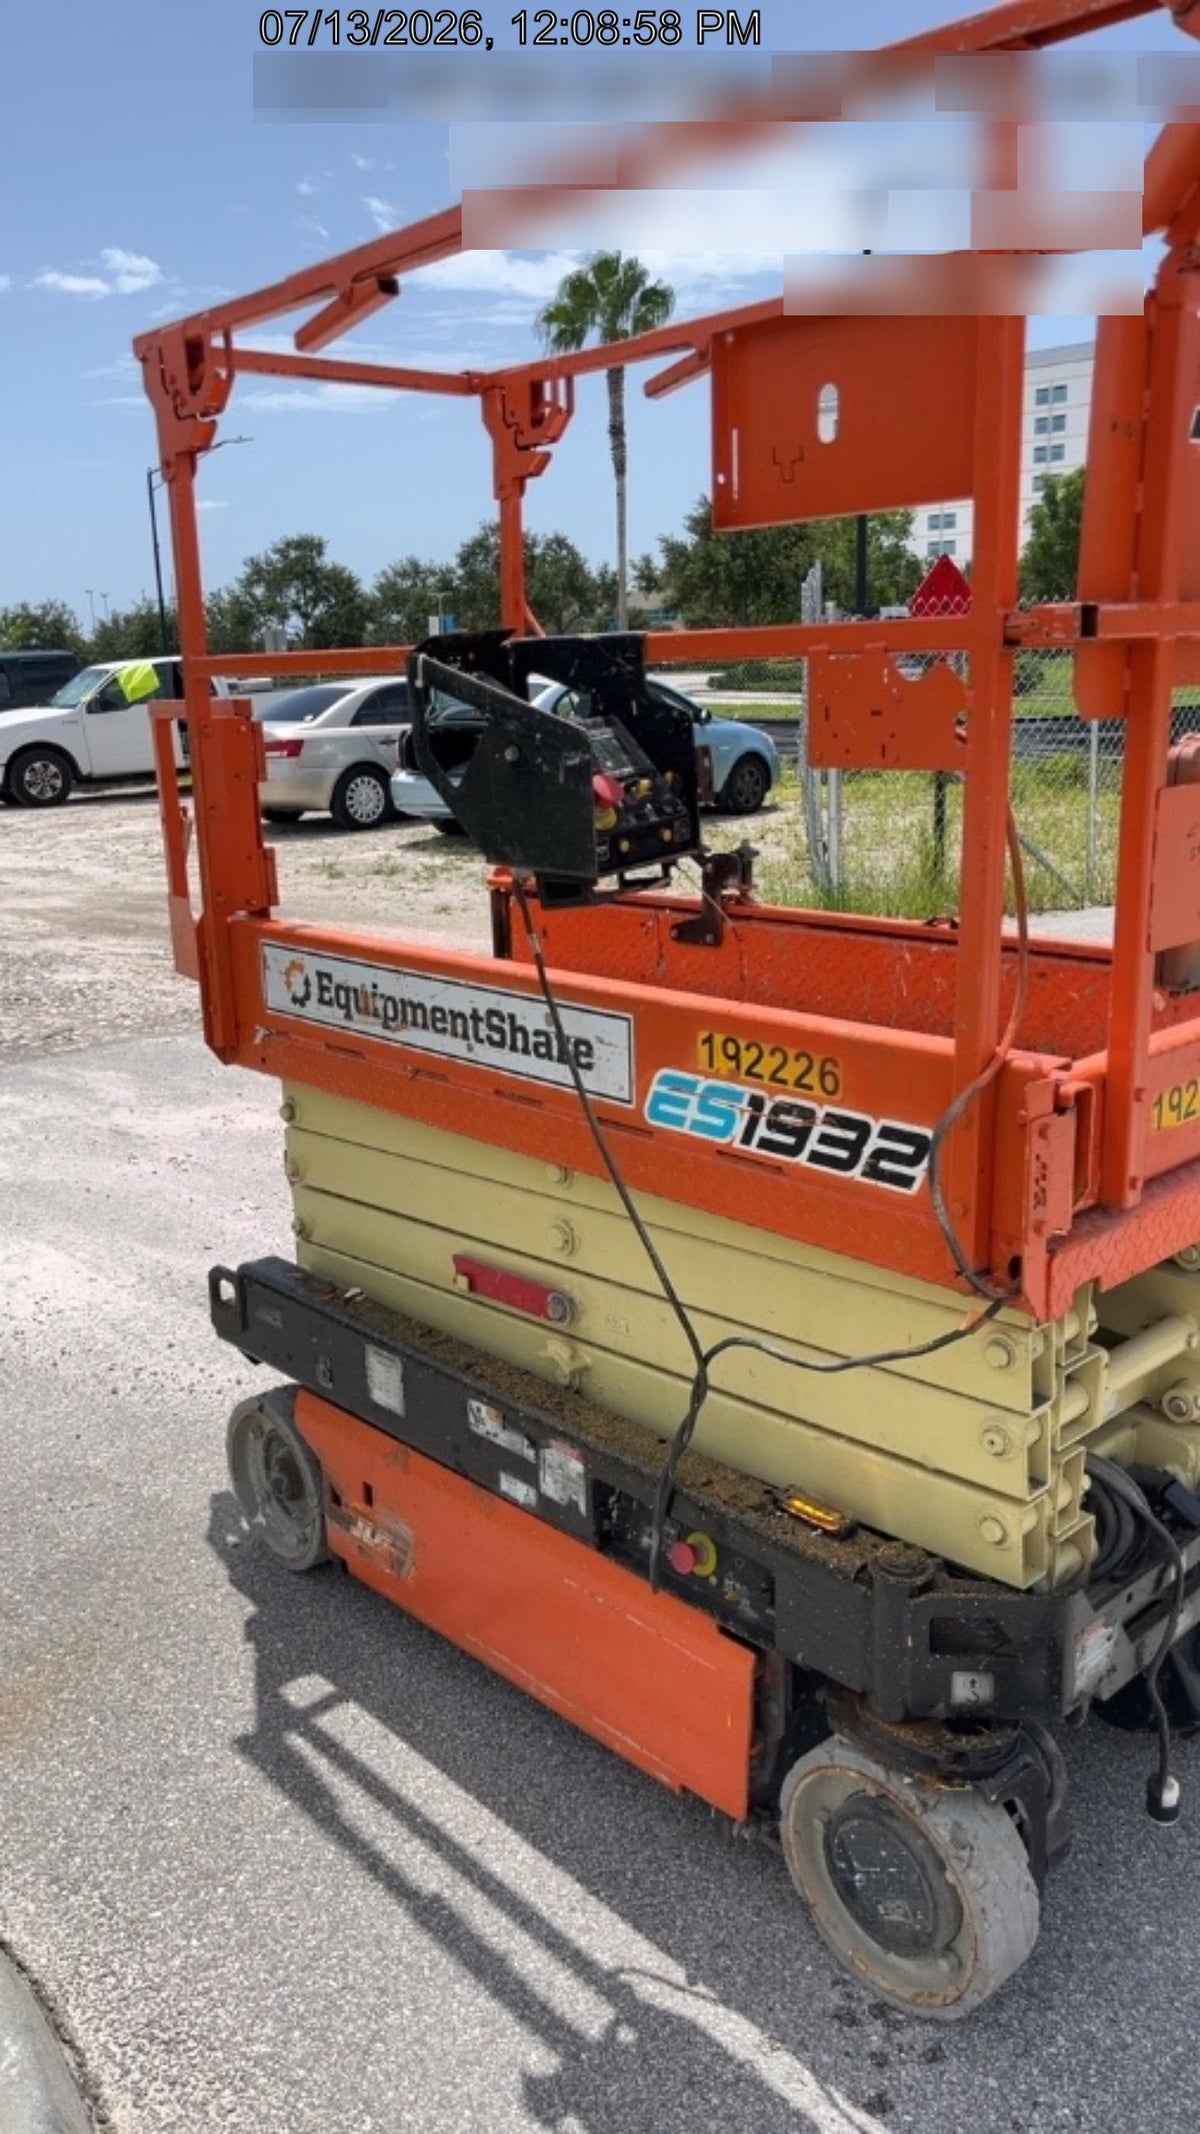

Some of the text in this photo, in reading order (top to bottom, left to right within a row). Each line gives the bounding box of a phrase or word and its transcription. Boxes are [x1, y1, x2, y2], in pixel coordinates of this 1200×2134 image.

[315, 970, 595, 1070] EquipmentShare
[701, 1032, 840, 1096] 192226
[646, 1070, 933, 1192] ES1932
